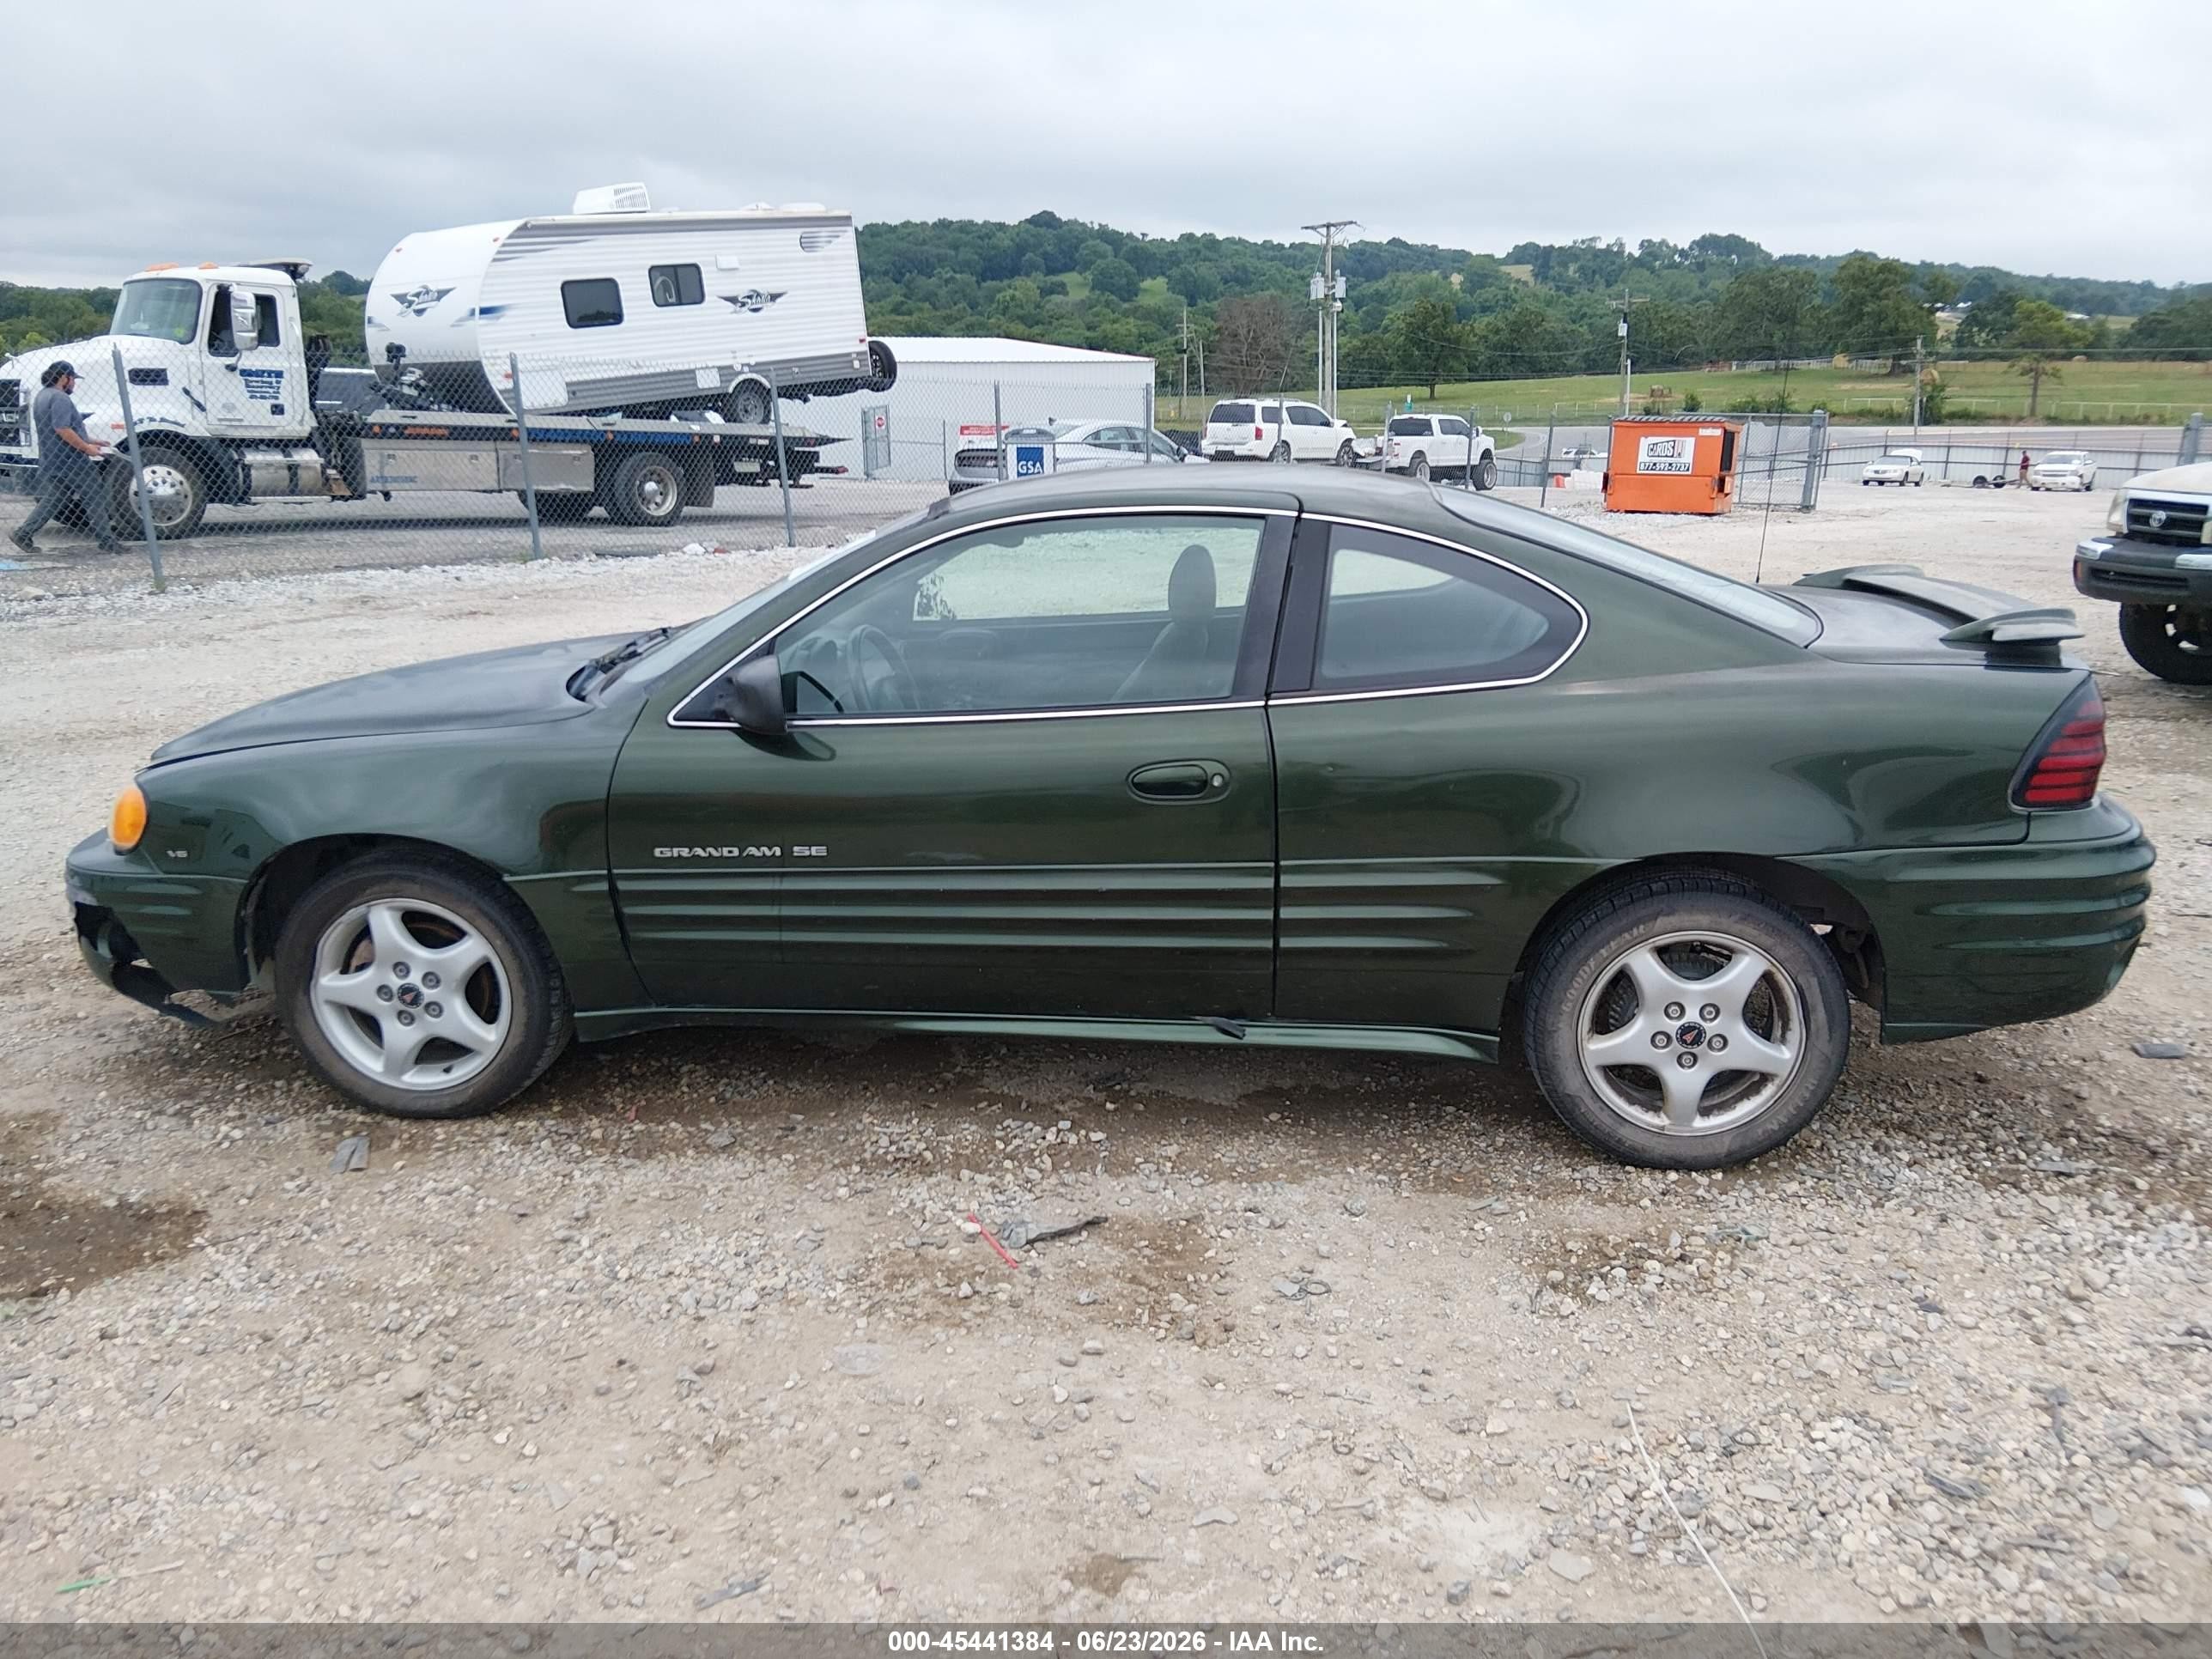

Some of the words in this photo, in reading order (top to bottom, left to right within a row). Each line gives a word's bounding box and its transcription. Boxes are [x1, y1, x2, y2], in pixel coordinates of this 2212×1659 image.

[1648, 441, 1675, 457] CARDS
[1018, 460, 1043, 474] GSA
[653, 847, 740, 858] GRAND
[742, 846, 782, 857] AM
[793, 846, 829, 857] SE
